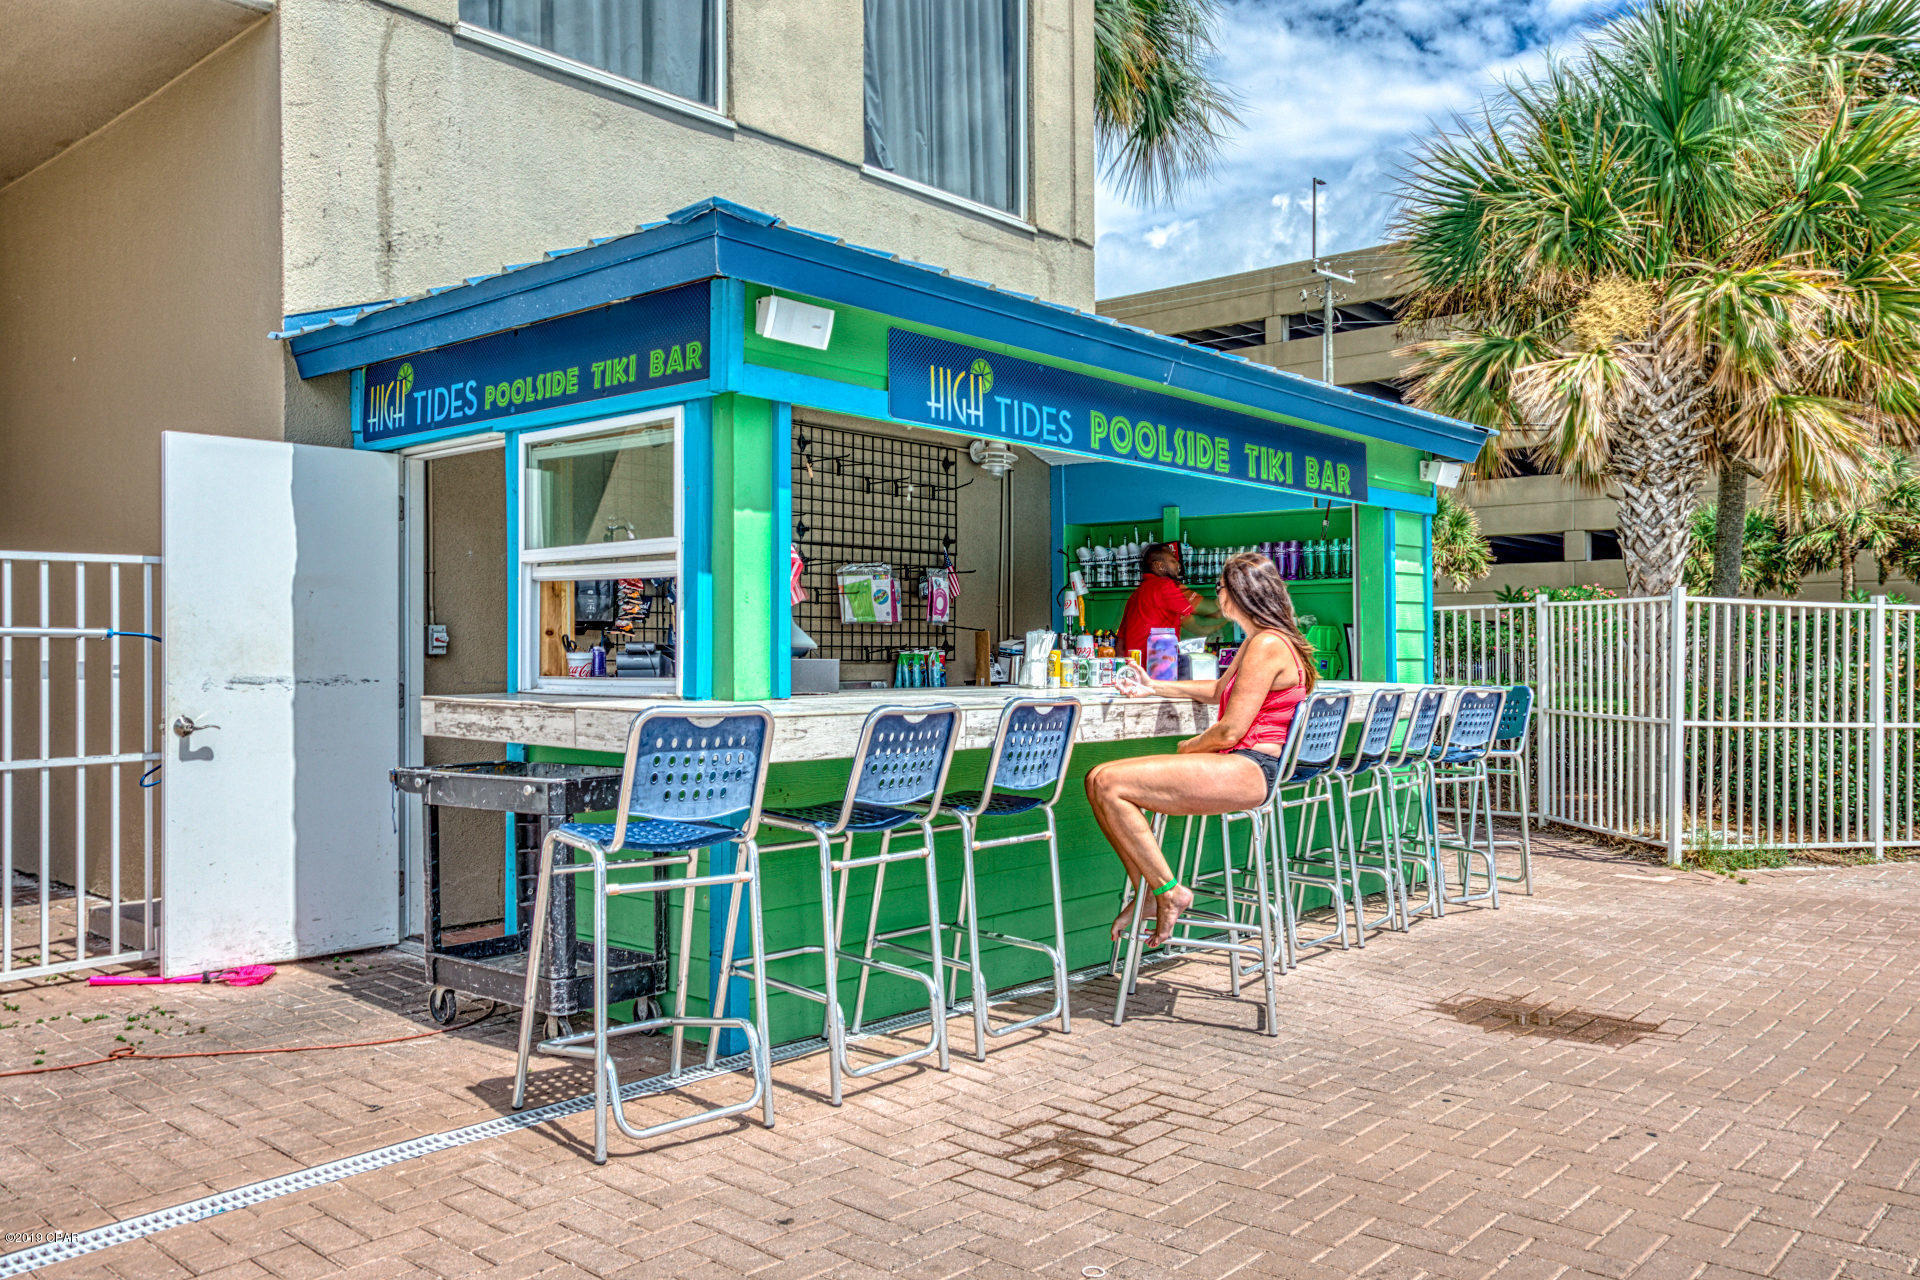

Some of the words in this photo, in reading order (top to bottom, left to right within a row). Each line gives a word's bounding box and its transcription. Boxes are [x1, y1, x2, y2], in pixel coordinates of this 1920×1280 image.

[367, 380, 406, 432] HIGH
[413, 380, 478, 425] TIDES
[484, 366, 580, 410] POOLSIDE
[591, 354, 637, 390] TIKI
[649, 341, 703, 378] BAR
[926, 365, 983, 427] HIGH
[994, 395, 1073, 444] TIDES
[1090, 409, 1231, 474] POOLSIDE
[1244, 442, 1294, 485] TIKI
[1305, 455, 1352, 496] BAR
